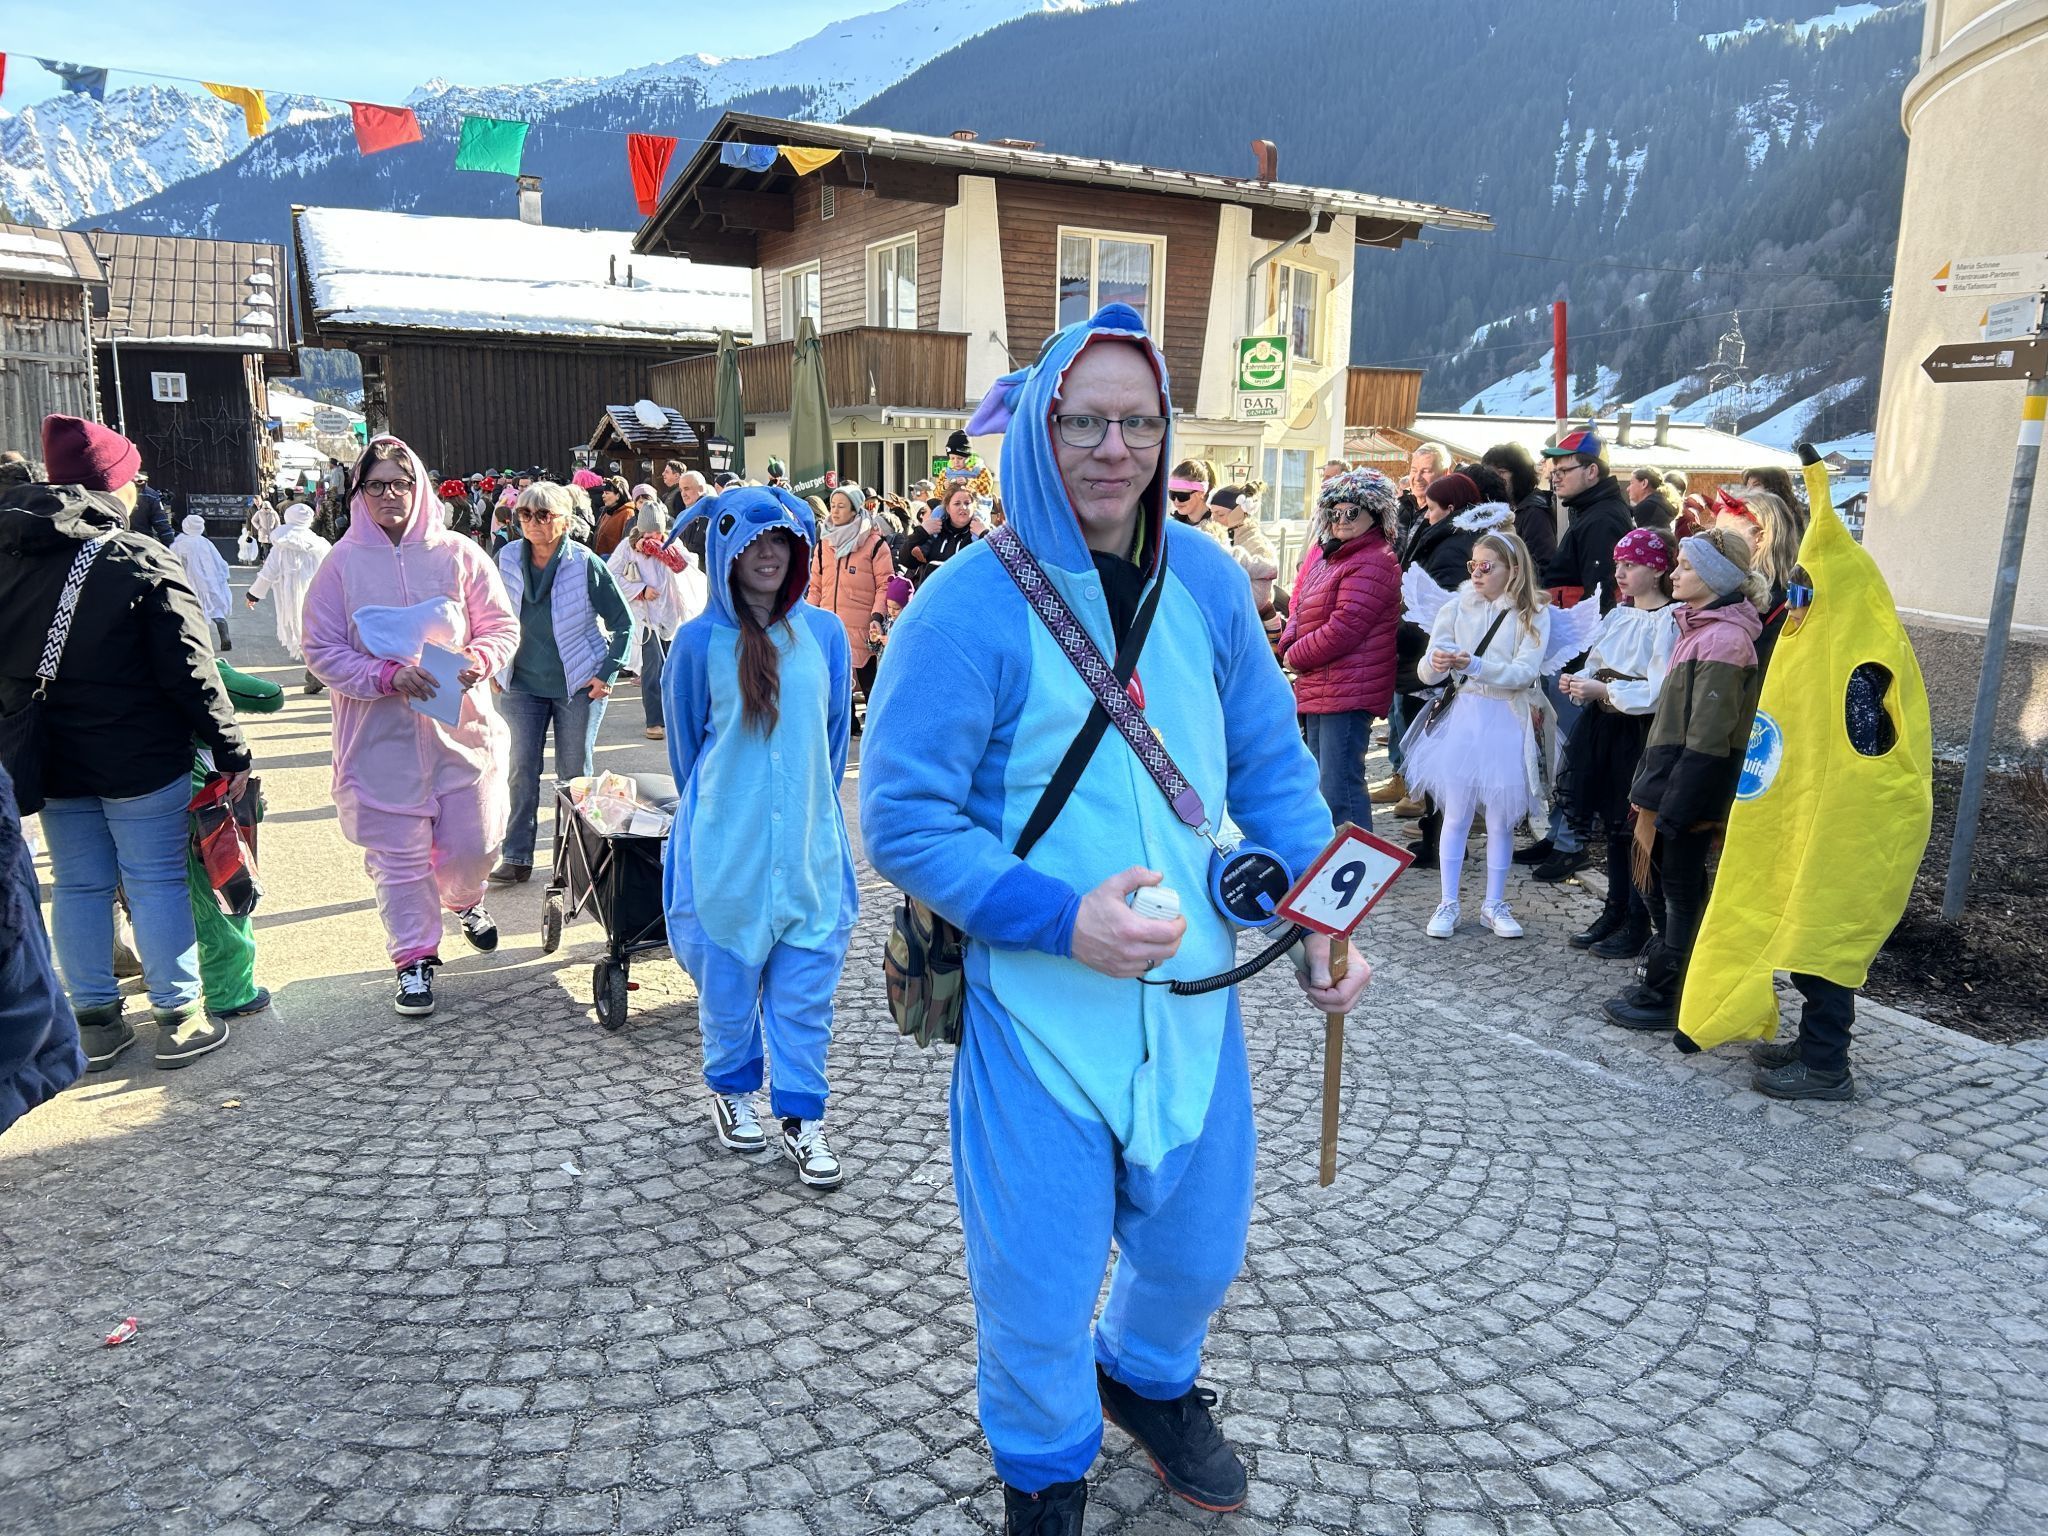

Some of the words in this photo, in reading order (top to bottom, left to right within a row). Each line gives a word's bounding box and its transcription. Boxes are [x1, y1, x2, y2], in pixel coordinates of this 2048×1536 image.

[1244, 397, 1274, 408] BAR
[1743, 757, 1765, 778] uita
[1331, 860, 1366, 910] 9
